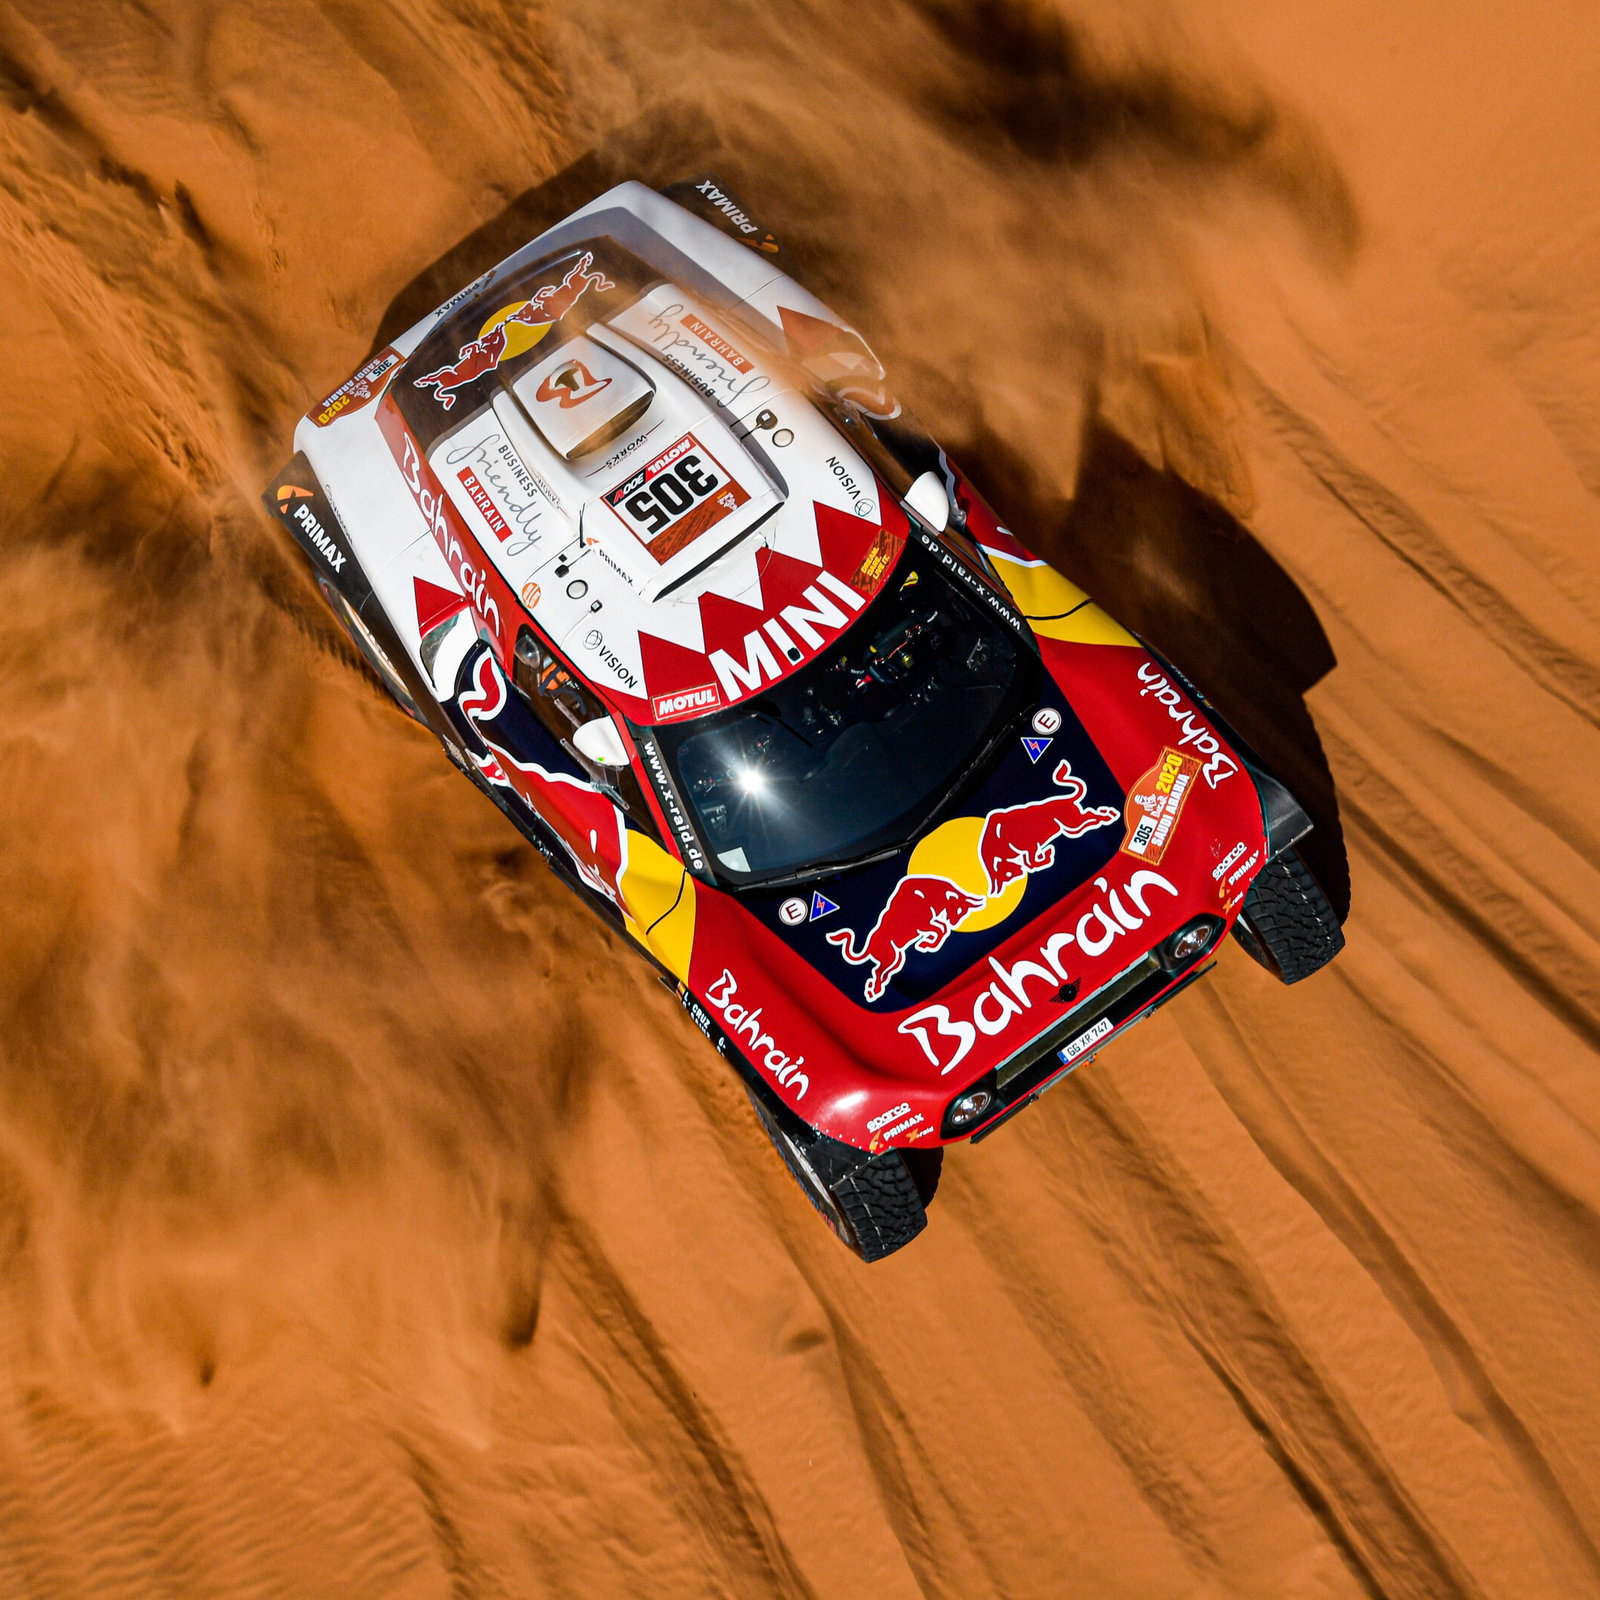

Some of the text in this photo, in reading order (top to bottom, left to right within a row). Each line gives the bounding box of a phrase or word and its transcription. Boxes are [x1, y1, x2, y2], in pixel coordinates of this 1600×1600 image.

[695, 180, 758, 235] PRIMAX
[434, 281, 481, 317] PRIMAX
[690, 320, 744, 367] BAHRAIN
[322, 358, 381, 407] SAUDI ARABIA
[373, 360, 392, 377] 305
[663, 353, 717, 399] BUSINESS
[318, 395, 350, 424] 2020
[498, 443, 537, 498] BUSINESS
[605, 434, 647, 466] WORKS
[647, 437, 691, 474] MOTUL
[445, 433, 544, 557] friendly
[624, 455, 719, 535] 305
[826, 456, 861, 500] VISION
[463, 475, 505, 534] BAHRAIN
[293, 503, 347, 573] PRIMAX
[402, 430, 501, 638] Bahrain
[598, 548, 634, 587] PRIMAX
[921, 533, 1021, 631] www.x-raid.de
[708, 570, 866, 702] MINI
[598, 644, 638, 689] VISION
[658, 692, 717, 716] MOTUL
[1038, 712, 1056, 730] E
[1137, 661, 1238, 789] Bahrain
[1156, 753, 1183, 794] 2020
[643, 740, 704, 871] www.x-raid.de
[1151, 773, 1191, 847] SAUDI ARABIA
[1134, 824, 1153, 846] 305
[1212, 842, 1247, 881] sparco
[787, 902, 803, 920] E
[898, 870, 1179, 1076] Bahrain
[692, 1003, 711, 1029] CRUZ
[705, 968, 810, 1101] Bahrain
[1067, 1021, 1108, 1057] GG XR 747
[866, 1102, 912, 1134] sparco
[883, 1113, 925, 1142] PRIMAX
